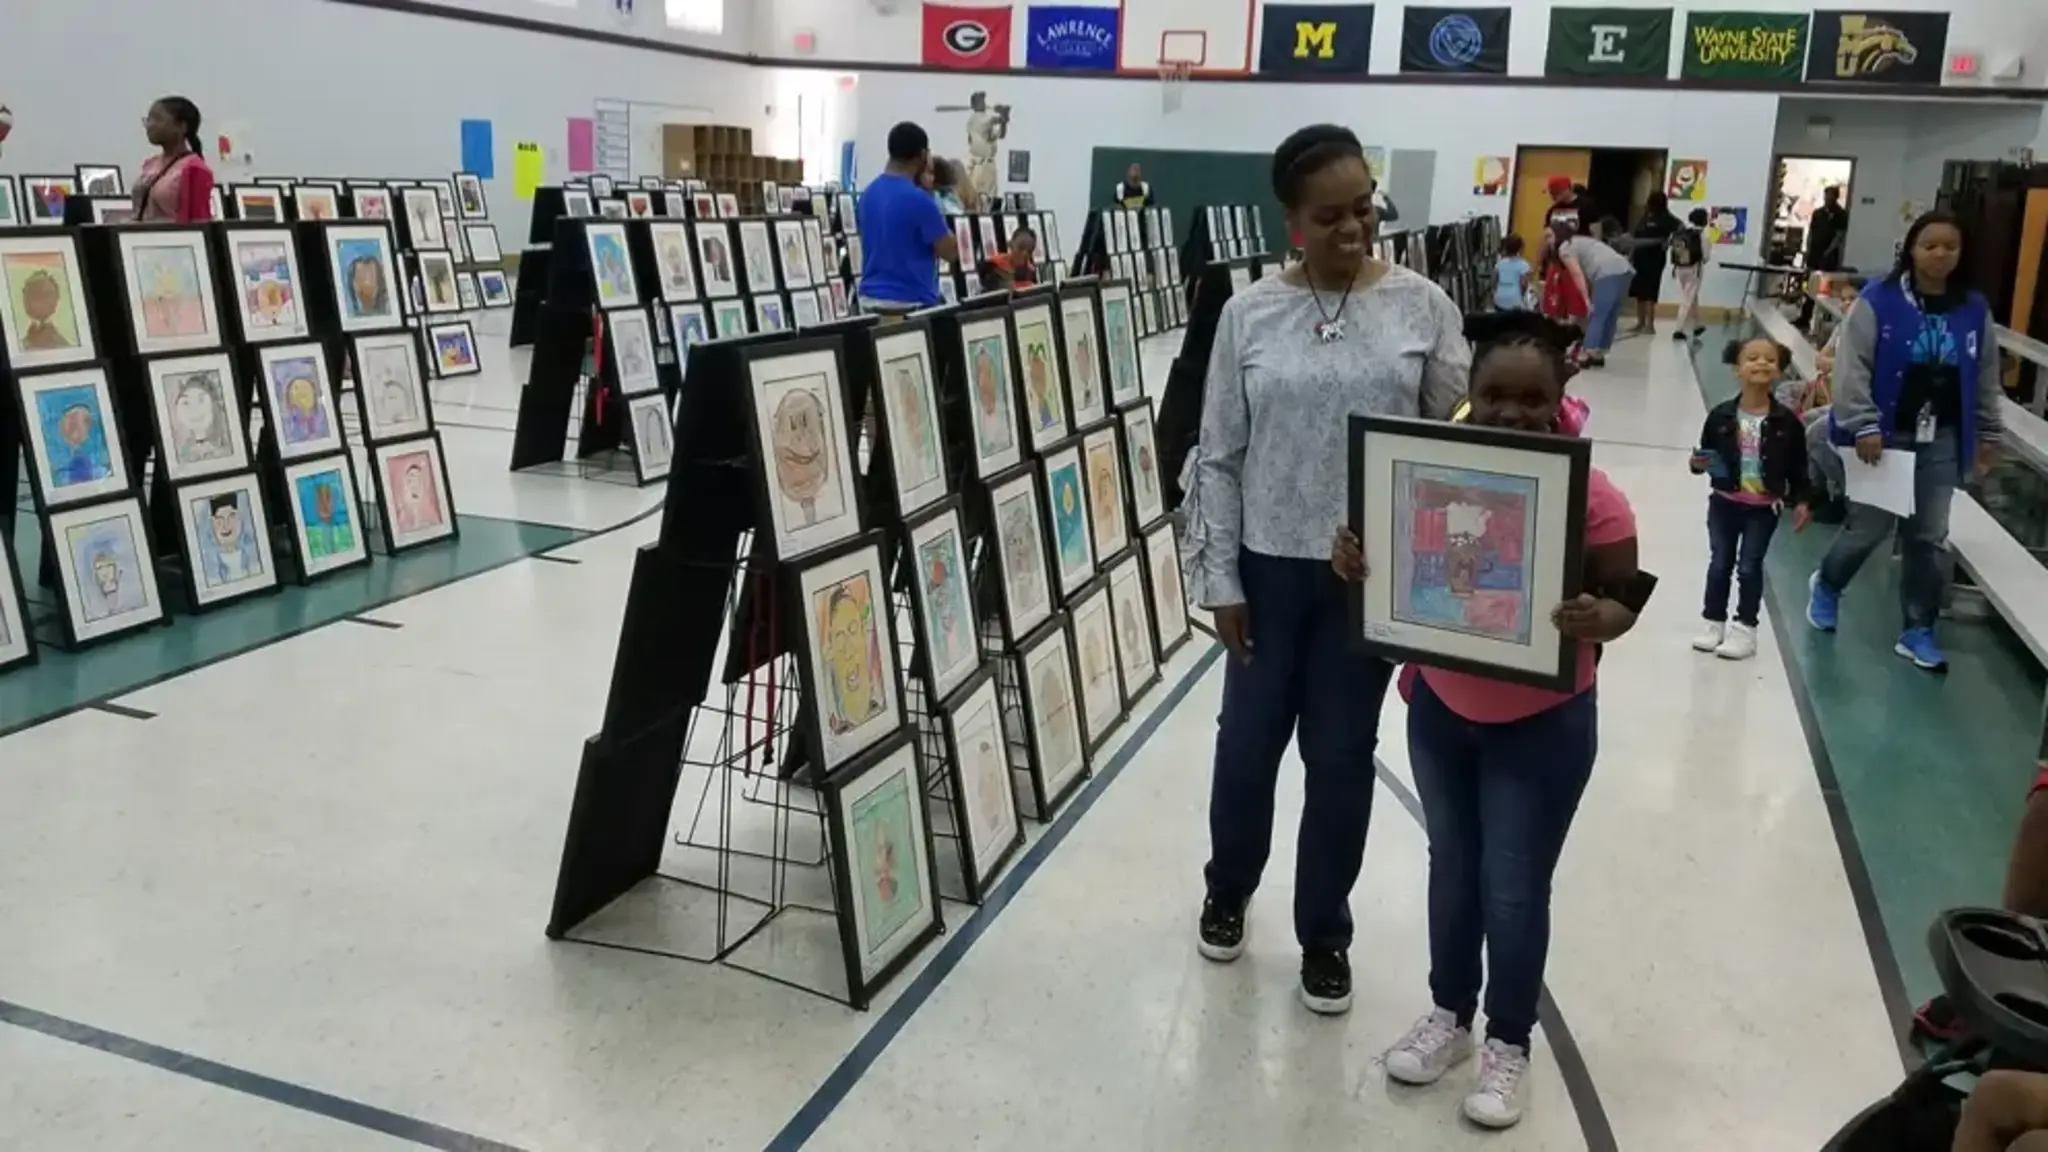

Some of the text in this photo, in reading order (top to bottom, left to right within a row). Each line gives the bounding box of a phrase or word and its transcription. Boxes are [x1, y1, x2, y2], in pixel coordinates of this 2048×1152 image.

[954, 26, 986, 49] G
[1036, 19, 1113, 49] LAWRENCE
[1293, 22, 1337, 59] M
[1587, 24, 1628, 63] E
[1693, 25, 1797, 48] WAYNE STATE
[1700, 42, 1791, 66] UNIVERSITY
